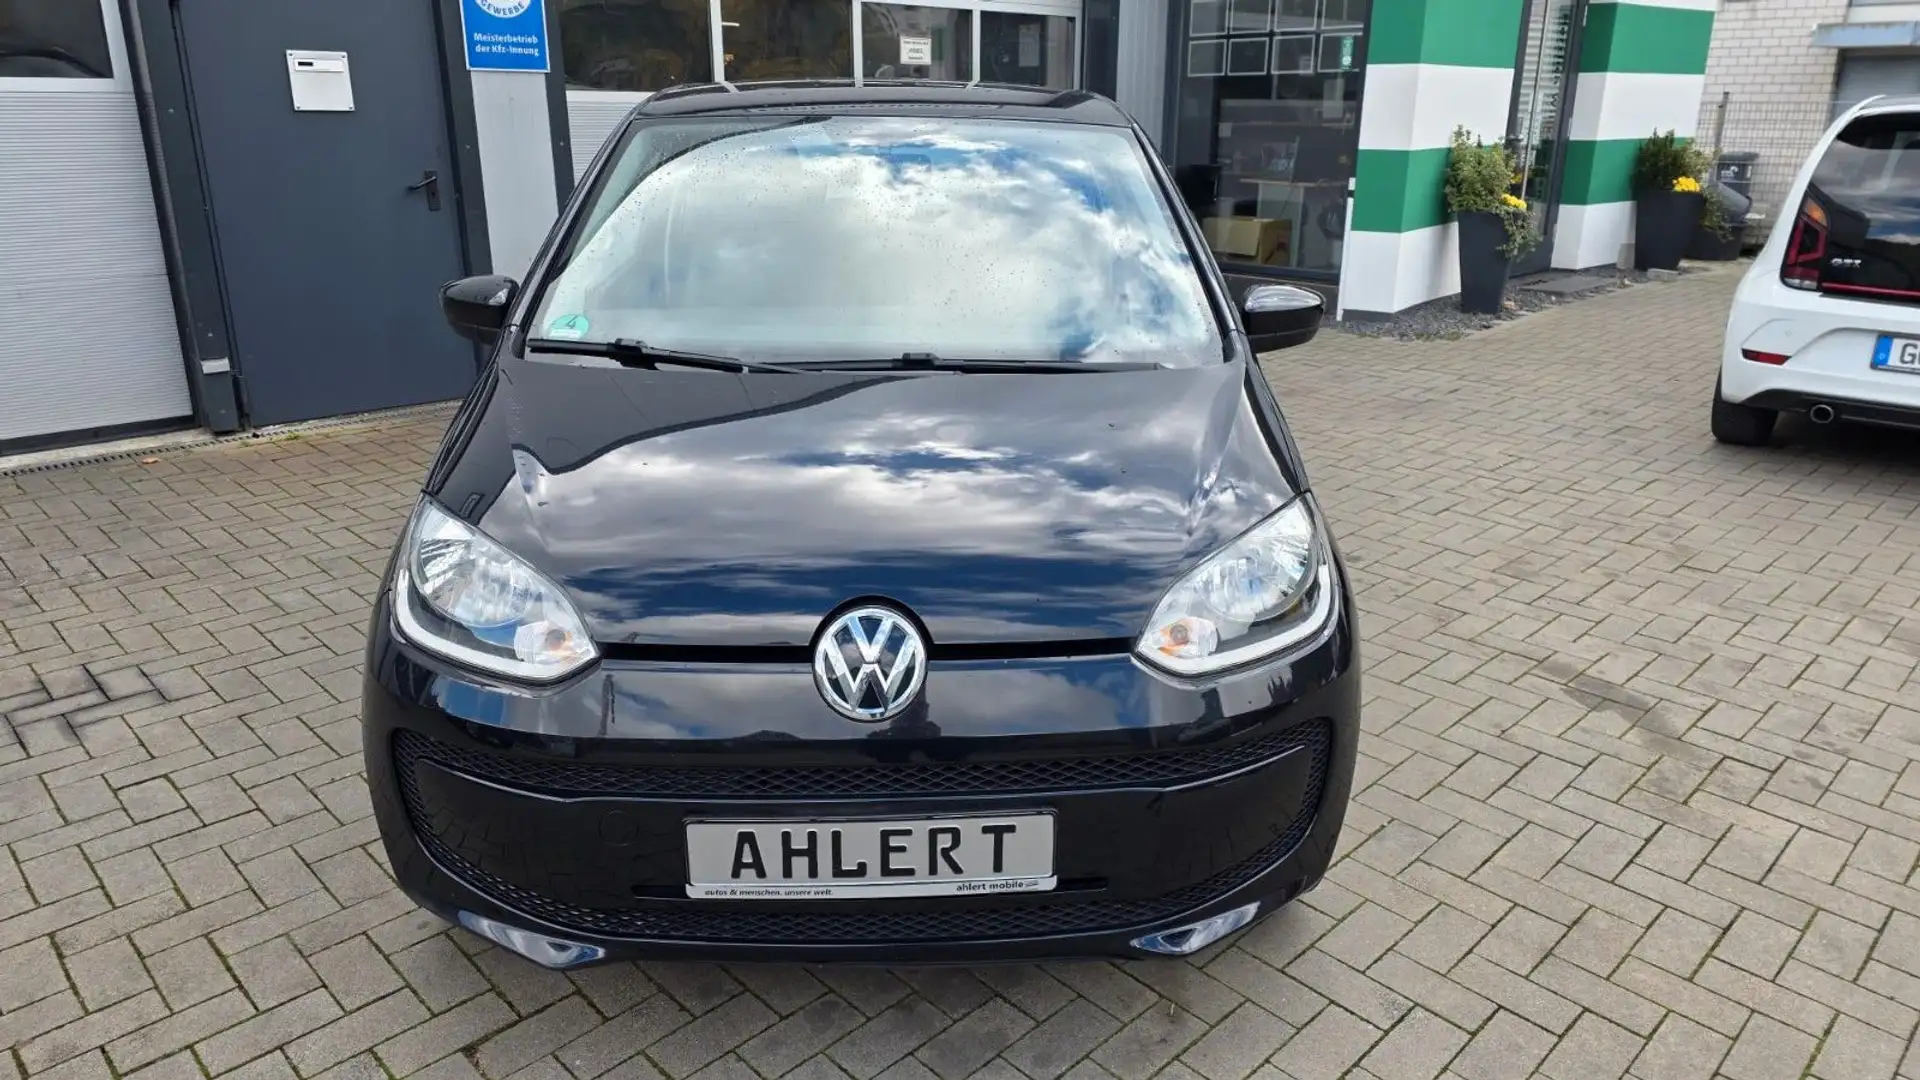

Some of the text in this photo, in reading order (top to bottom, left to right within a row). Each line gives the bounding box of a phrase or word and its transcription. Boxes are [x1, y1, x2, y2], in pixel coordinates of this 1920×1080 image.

[473, 32, 538, 44] Meisterbetrieb
[475, 43, 539, 57] der Kfz-Innung
[565, 314, 579, 329] 4
[1899, 342, 1920, 365] G
[730, 824, 1016, 879] AHLERT
[956, 881, 1024, 892] ahlert mobile
